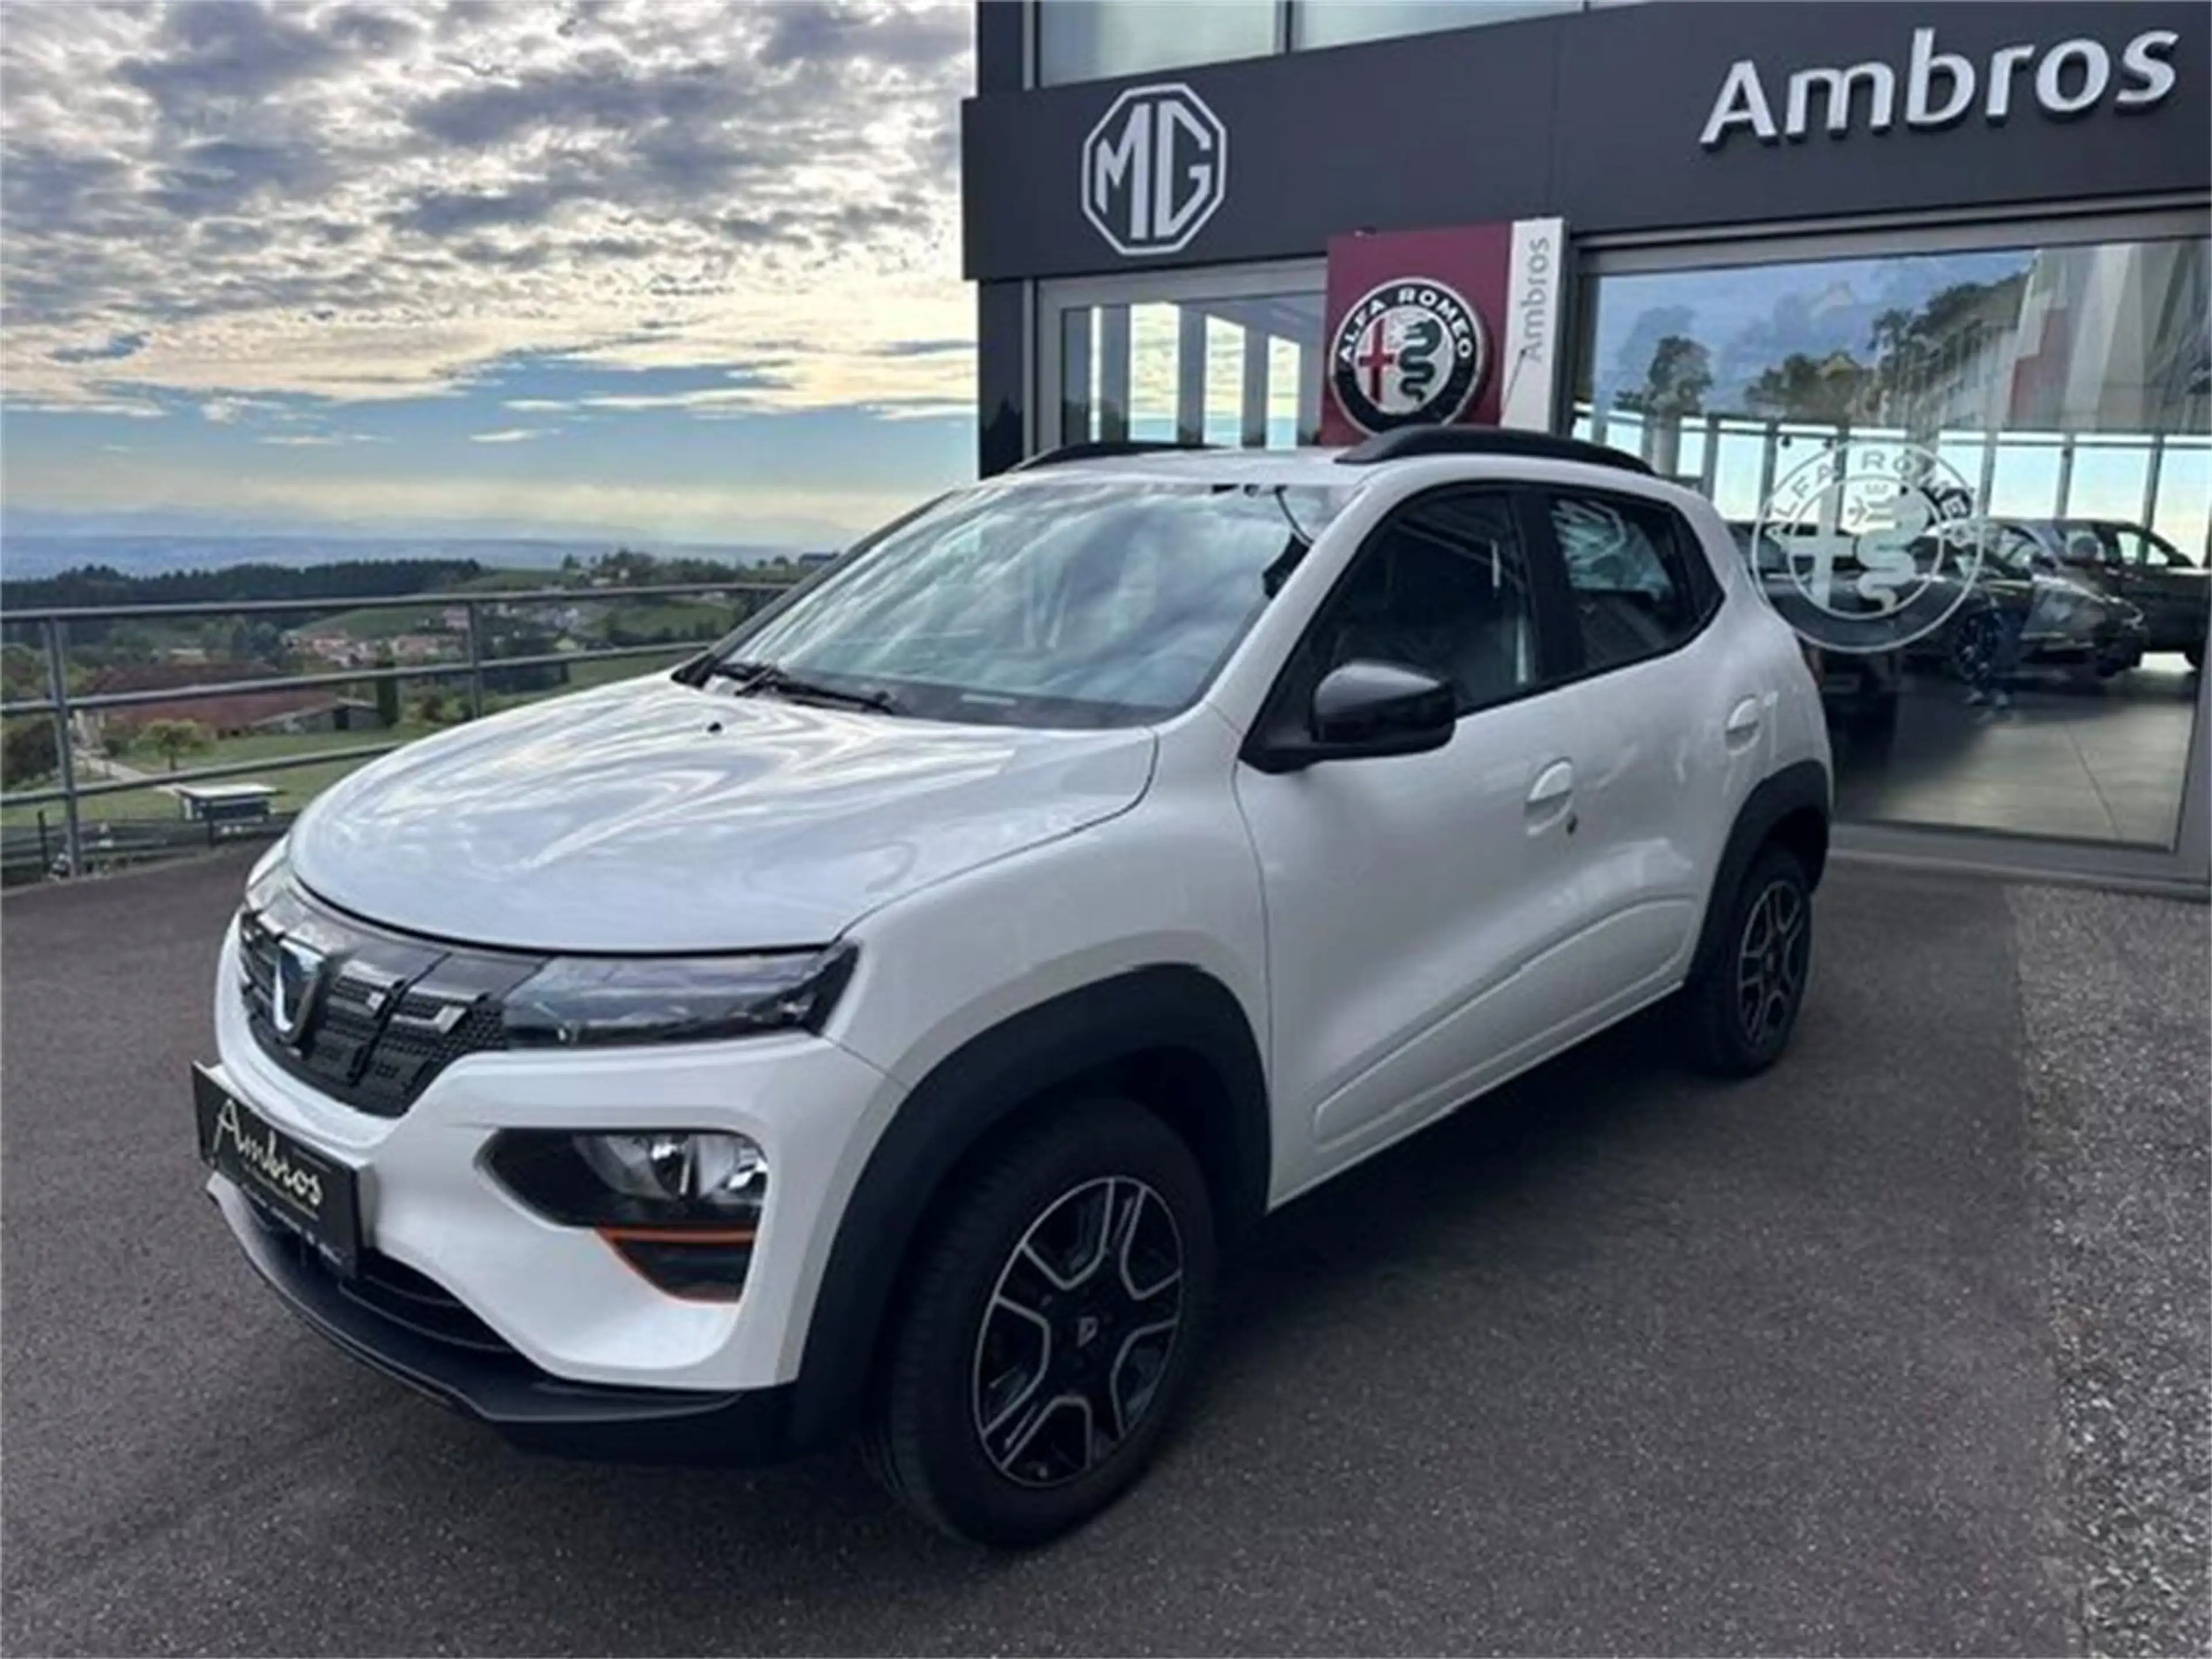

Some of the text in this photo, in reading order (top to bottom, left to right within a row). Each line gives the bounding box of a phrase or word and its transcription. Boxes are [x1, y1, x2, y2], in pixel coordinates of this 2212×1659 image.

[1699, 27, 2180, 151] Ambros
[1096, 99, 1212, 240] MG
[1339, 286, 1475, 364] ALFA ROMEO
[1521, 236, 1550, 364] Ambros
[1764, 450, 1977, 551] ALFA ROMEO
[212, 1097, 324, 1206] Ambros
